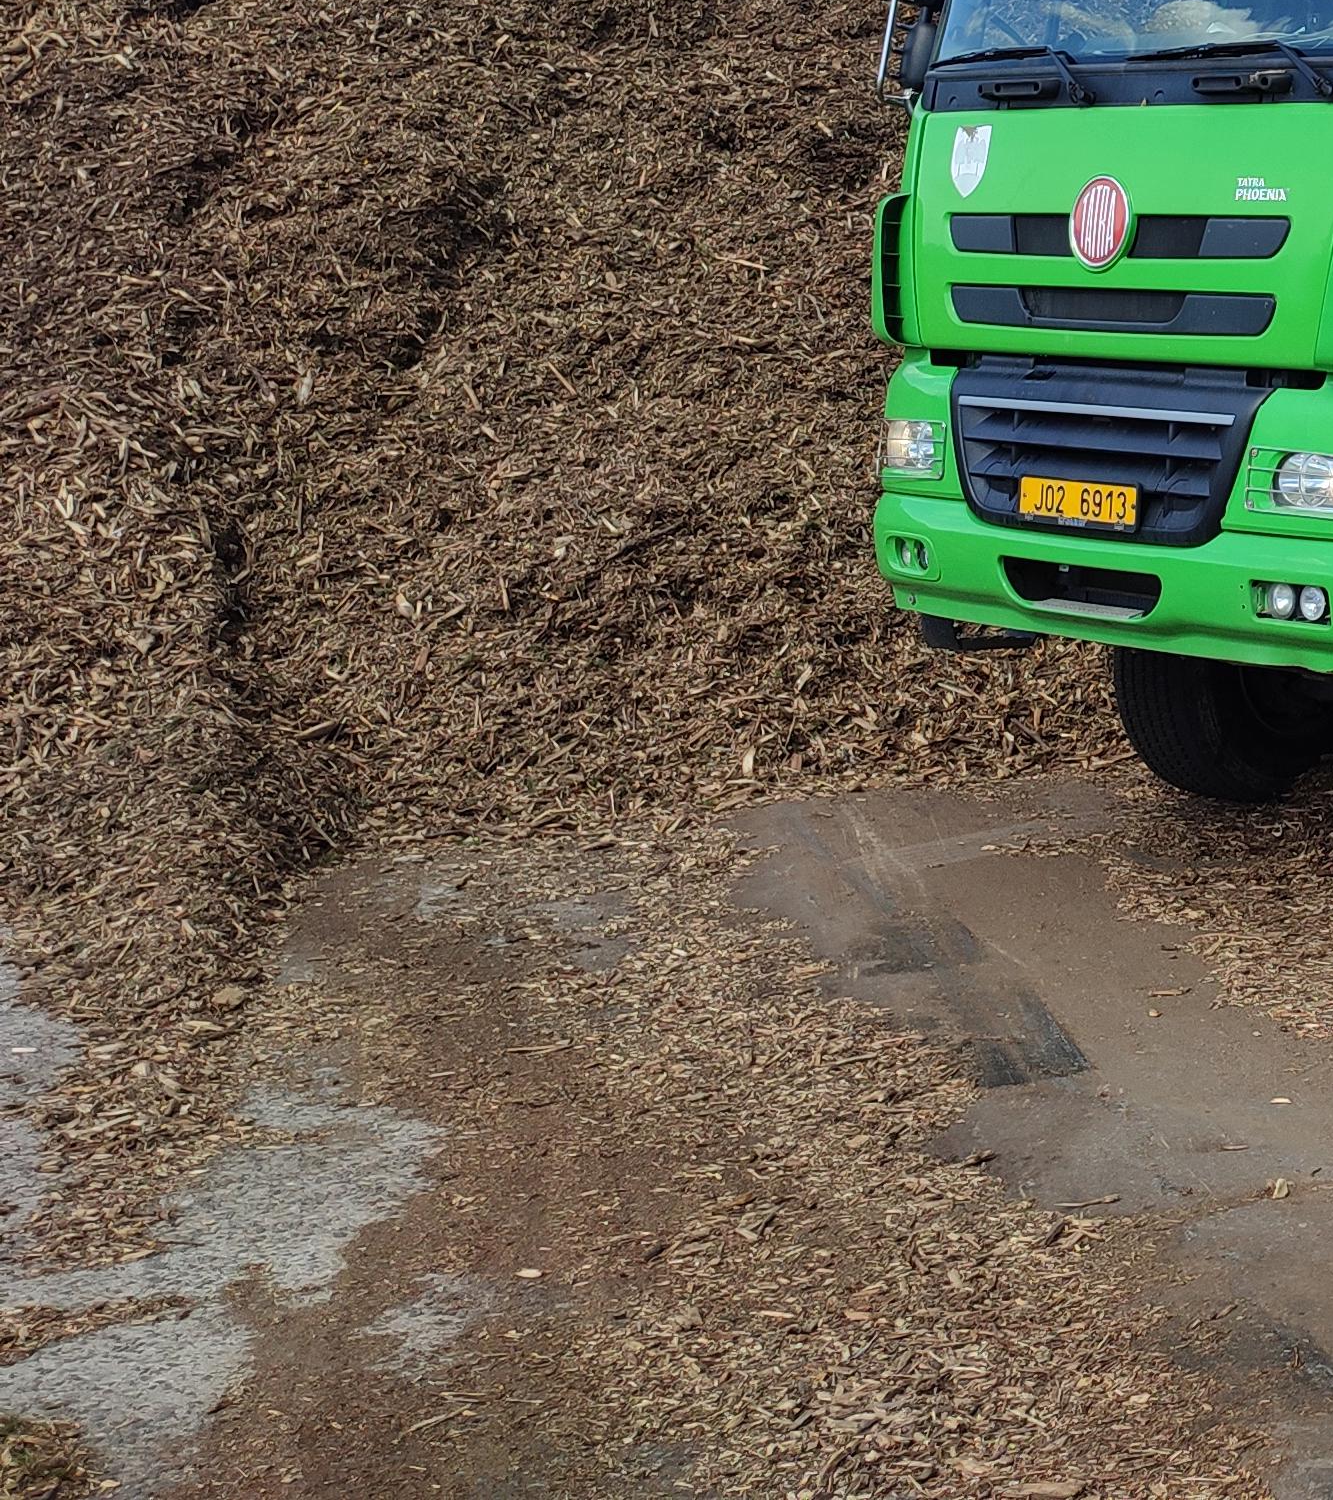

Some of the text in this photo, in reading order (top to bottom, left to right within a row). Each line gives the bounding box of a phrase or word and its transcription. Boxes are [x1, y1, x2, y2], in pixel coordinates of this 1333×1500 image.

[1236, 177, 1265, 187] TATRA
[1080, 184, 1116, 258] TATRA
[1080, 487, 1127, 520] 6913
